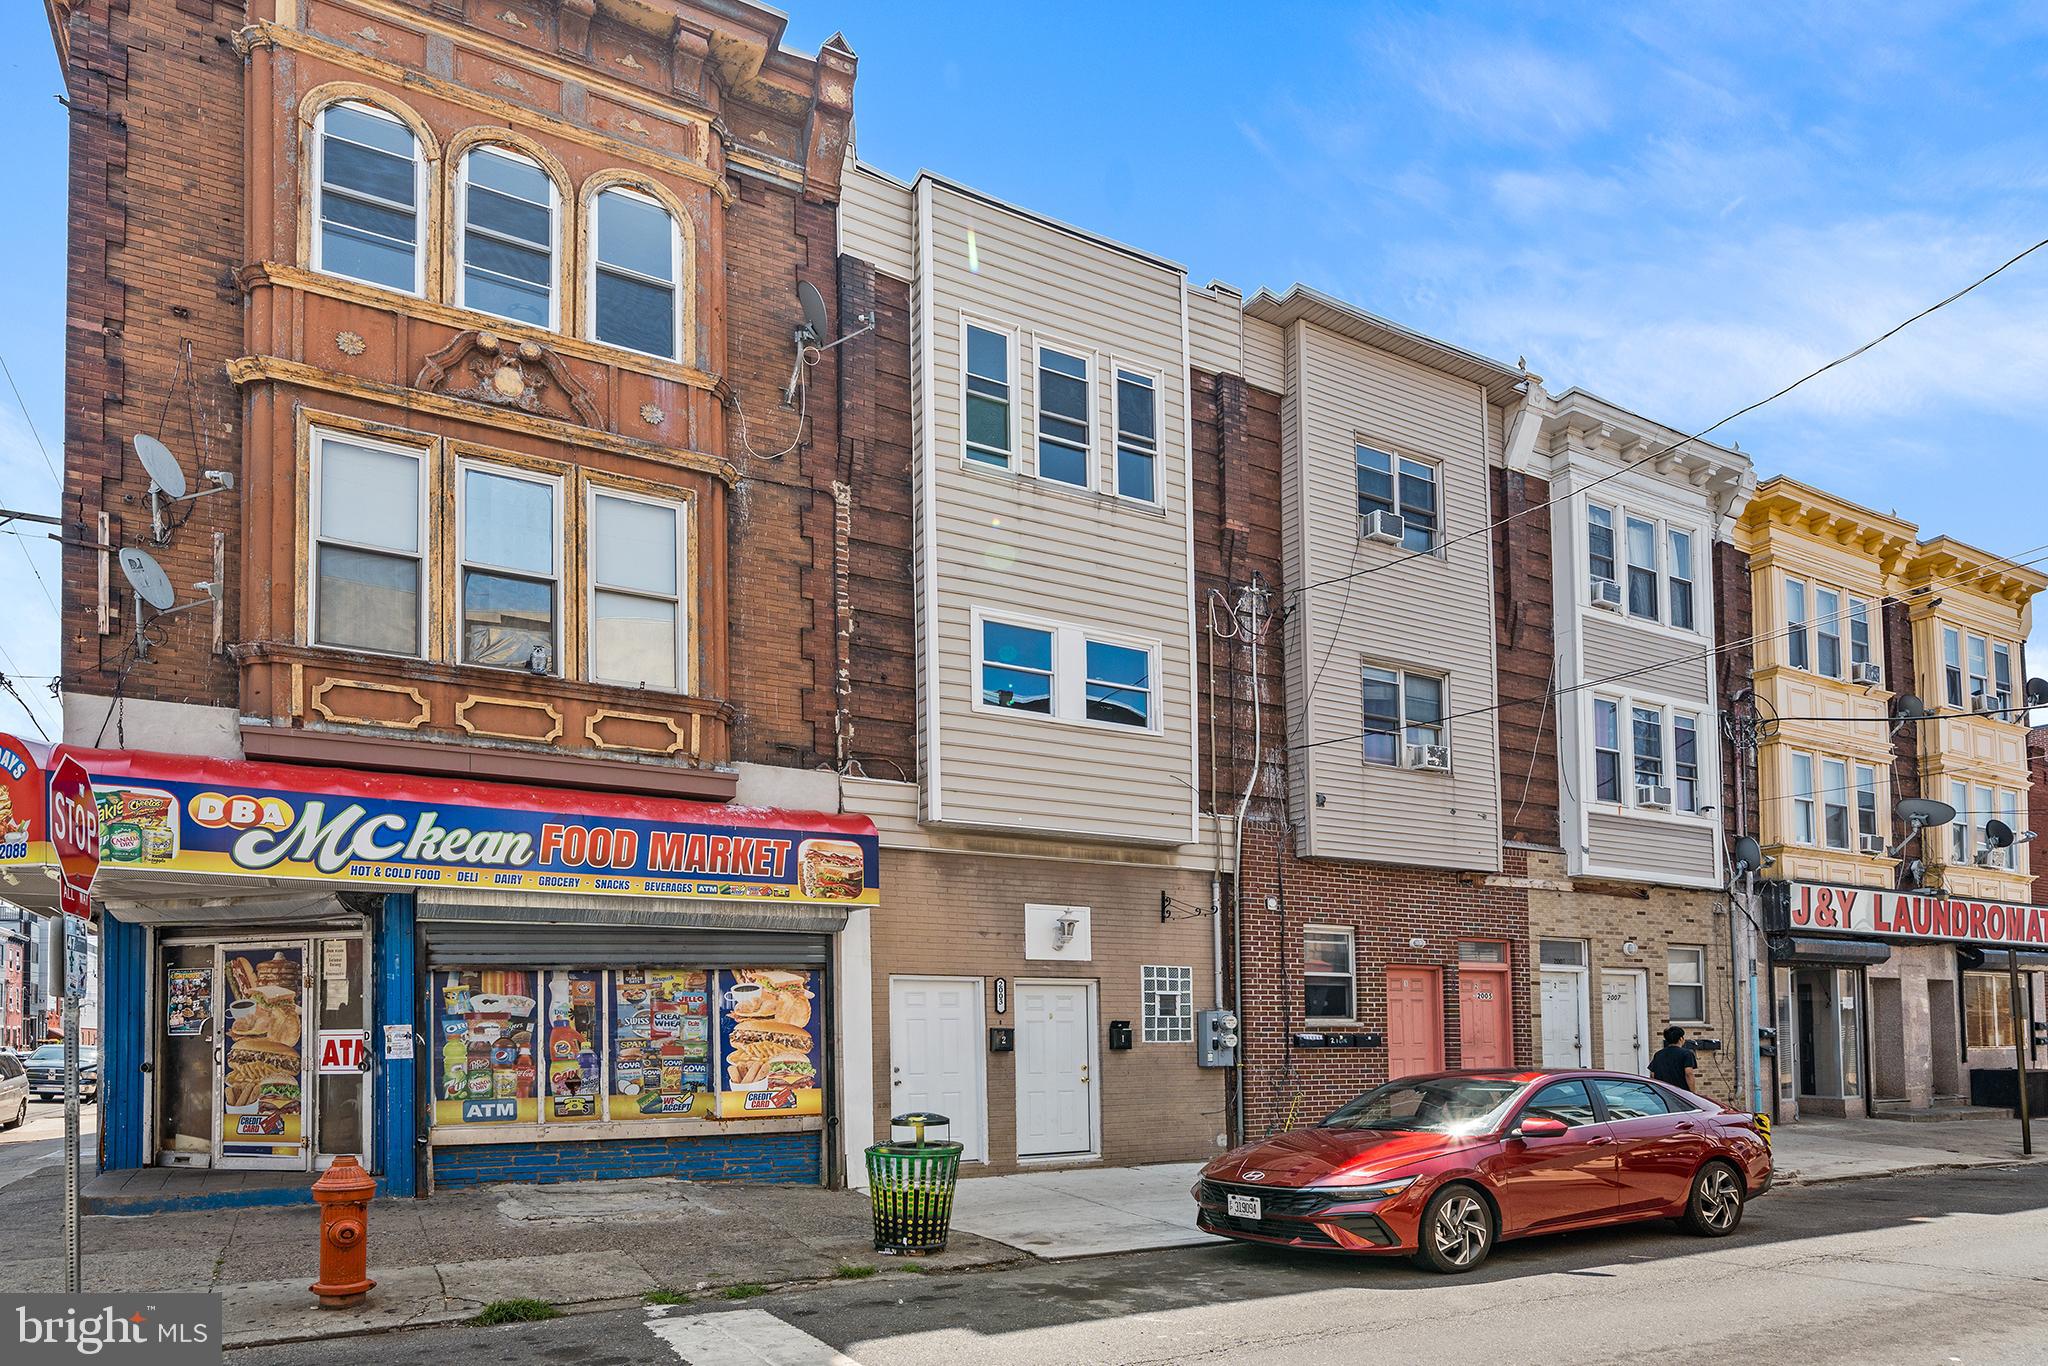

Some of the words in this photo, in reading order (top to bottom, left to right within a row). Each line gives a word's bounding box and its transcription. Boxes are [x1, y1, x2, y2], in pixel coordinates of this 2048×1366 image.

[0, 748, 27, 781] AYS
[198, 797, 286, 826] DBA
[55, 791, 97, 854] STOP
[539, 824, 638, 870] FOOD
[647, 831, 792, 877] MARKET
[350, 865, 371, 876] HOT
[374, 866, 381, 877] &
[384, 867, 411, 879] COLD
[414, 869, 440, 881] FOOD
[457, 871, 478, 882] DELI
[494, 874, 523, 885] DAIRY
[539, 876, 580, 888] GROCERY
[595, 879, 630, 890] SNACKS
[644, 881, 693, 893] BEVERAGES
[698, 885, 717, 893] ATM
[1791, 887, 1857, 929] J&Y
[1873, 894, 2048, 943] LAUNDROMAT
[654, 1020, 681, 1028] WHEA
[1001, 1036, 1006, 1044] 2
[620, 1041, 647, 1049] SPAM
[617, 1062, 641, 1070] GOYA
[683, 1064, 706, 1073] GOYA
[663, 1096, 675, 1104] WE
[748, 1093, 772, 1101] CREDIT
[662, 1103, 691, 1111] ACCEPT
[751, 1100, 770, 1108] CARD
[466, 1103, 514, 1118] ATM
[241, 1116, 262, 1125] CREDIT
[243, 1125, 260, 1133] CARD
